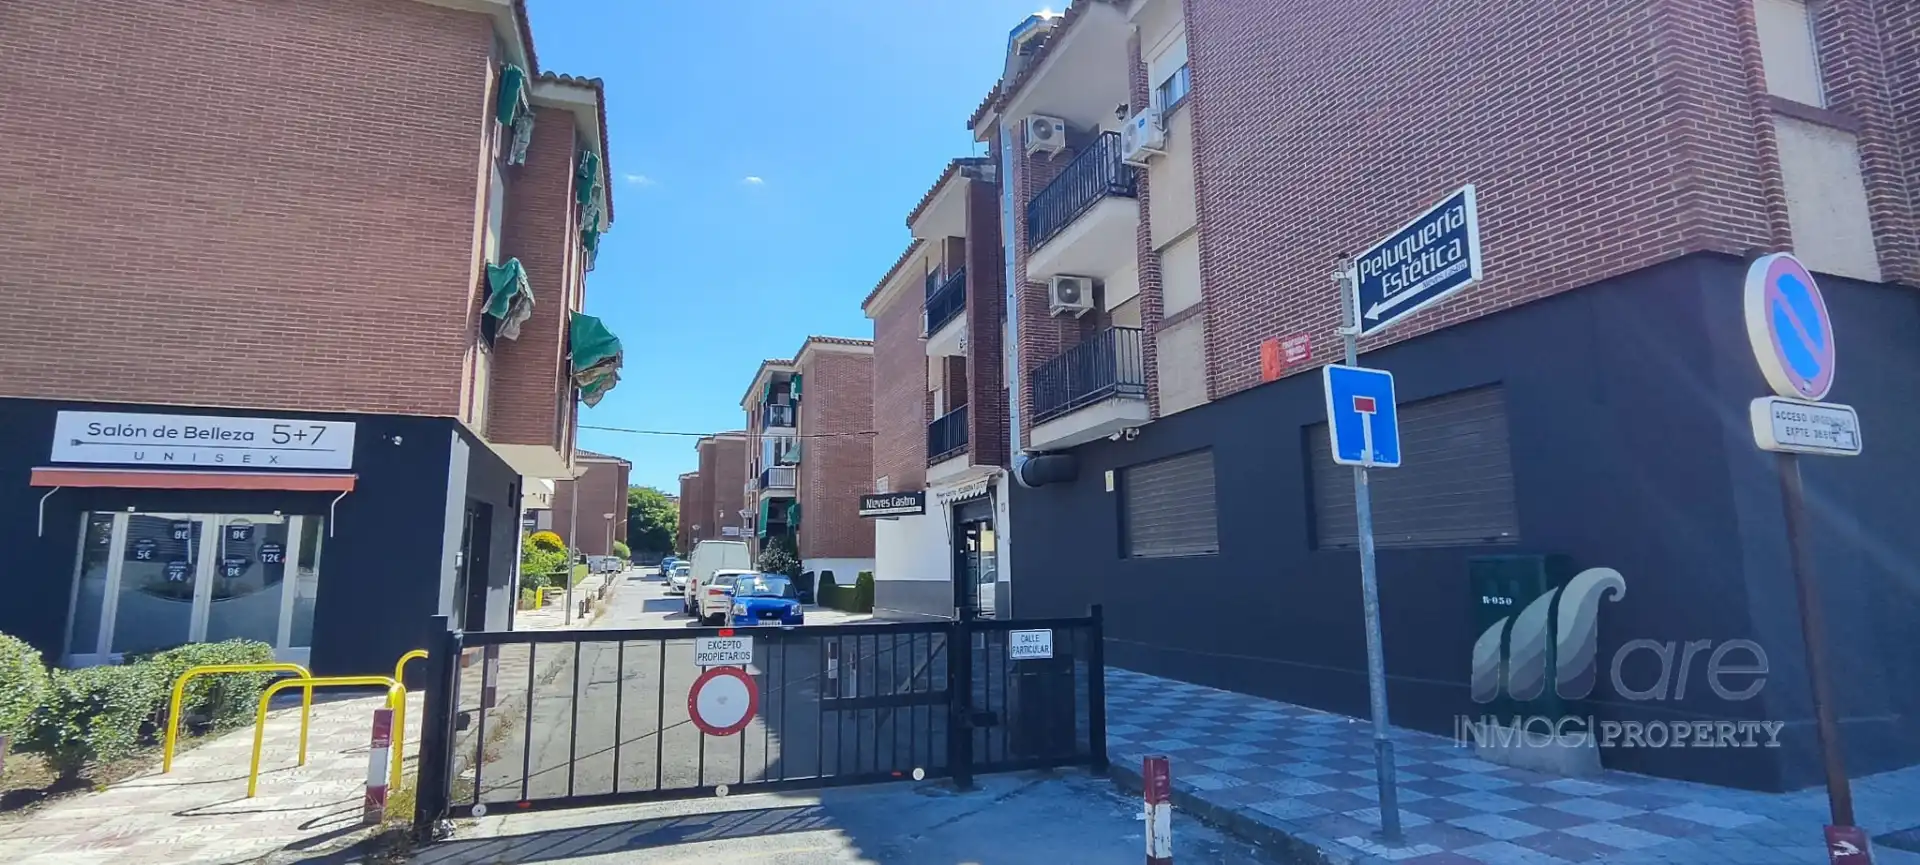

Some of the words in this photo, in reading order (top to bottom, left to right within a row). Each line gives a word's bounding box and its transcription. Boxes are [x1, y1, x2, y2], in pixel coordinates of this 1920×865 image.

[1360, 205, 1464, 284] Peluquería
[1382, 238, 1461, 298] Estética
[1775, 411, 1808, 422] ACCESO
[87, 422, 147, 439] Salón
[153, 424, 179, 439] de
[184, 425, 255, 442] Belleza
[272, 424, 327, 446] 5+7
[1785, 426, 1810, 438] EXPTE
[866, 497, 890, 509] Nieves
[891, 495, 916, 507] Castro
[136, 550, 152, 560] 5€
[261, 553, 281, 563] 12€
[169, 571, 184, 581] 7€
[1020, 634, 1040, 643] CALLE
[708, 640, 741, 650] EXCEPTO
[1012, 644, 1050, 655] PARTICULAR
[697, 651, 751, 662] PROPIETARIOS
